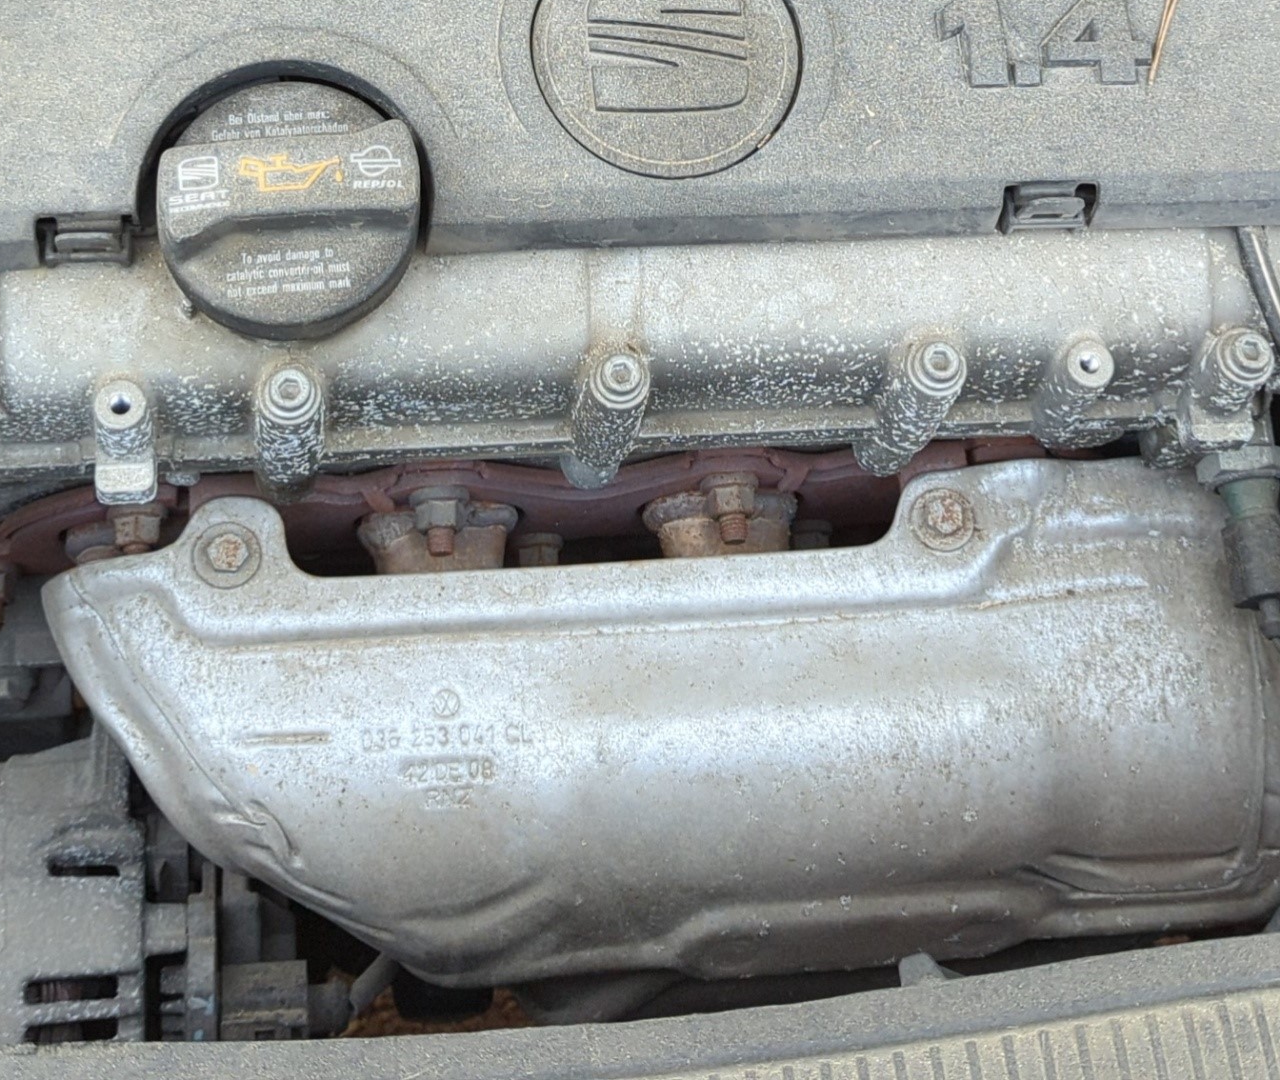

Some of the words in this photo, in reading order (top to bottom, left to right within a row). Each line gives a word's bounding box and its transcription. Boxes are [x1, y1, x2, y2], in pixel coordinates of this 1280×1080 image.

[228, 114, 243, 126] Bei
[211, 128, 241, 141] Gefahr
[244, 129, 261, 139] von
[353, 179, 405, 189] REPSOL
[169, 189, 230, 206] SEAT
[241, 252, 253, 264] To
[256, 250, 281, 264] avoid
[285, 250, 320, 262] damage
[324, 247, 334, 258] to
[226, 268, 265, 282] catalytic
[327, 261, 350, 273] must
[227, 286, 242, 298] not
[246, 282, 278, 296] exceed
[282, 280, 325, 292] maximum
[329, 276, 351, 289] mark
[412, 726, 449, 747] 253
